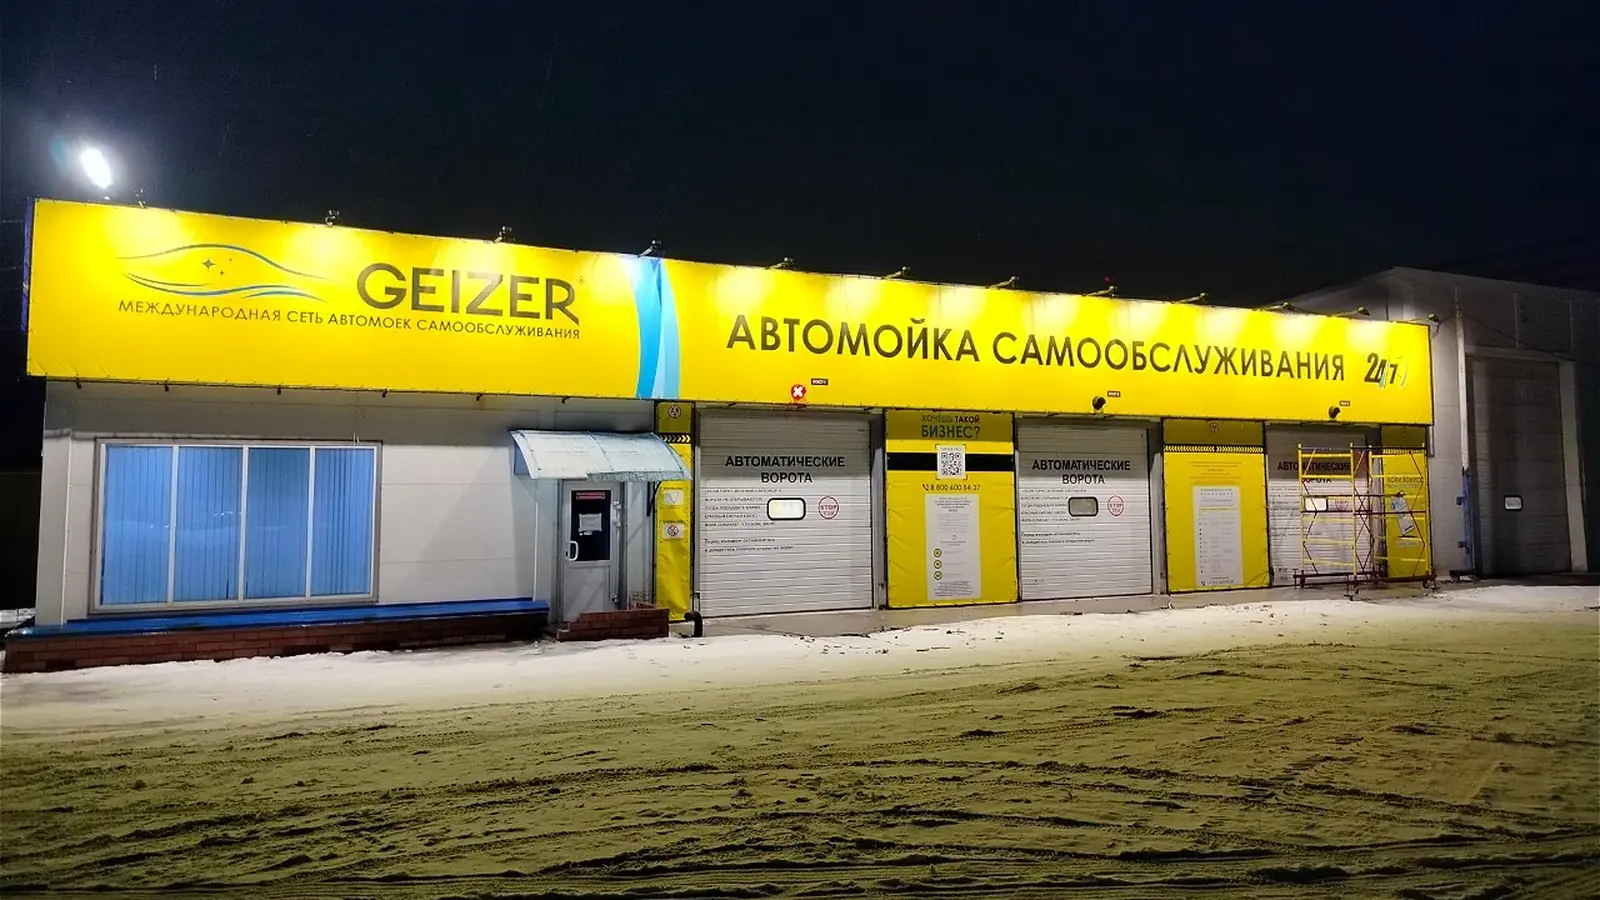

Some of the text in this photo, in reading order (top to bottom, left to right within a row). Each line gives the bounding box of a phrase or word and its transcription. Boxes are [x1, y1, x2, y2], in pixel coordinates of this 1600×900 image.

[357, 263, 579, 325] GEIZER
[118, 299, 580, 339] МЕЖДУНАРОДНАЯ СЕТЬ АВТОМОЕК САМООБСЛУЖИВАНИЯ
[726, 315, 980, 363] АВТОМОЙКА
[992, 332, 1345, 382] САМООБСЛУЖИВАНИЯ
[955, 414, 980, 424] ТАКОЙ
[921, 424, 981, 439] БИЗНЕС?
[724, 455, 846, 468] АВТОМАТИЧЕСКИЕ
[1031, 459, 1131, 471] АВТОМАТИЧЕСКИЕ
[1277, 461, 1351, 471] АВТОАТИЧЕСКИЕ
[760, 472, 813, 484] ВОРОТА
[1061, 474, 1106, 485] ВОРОТА
